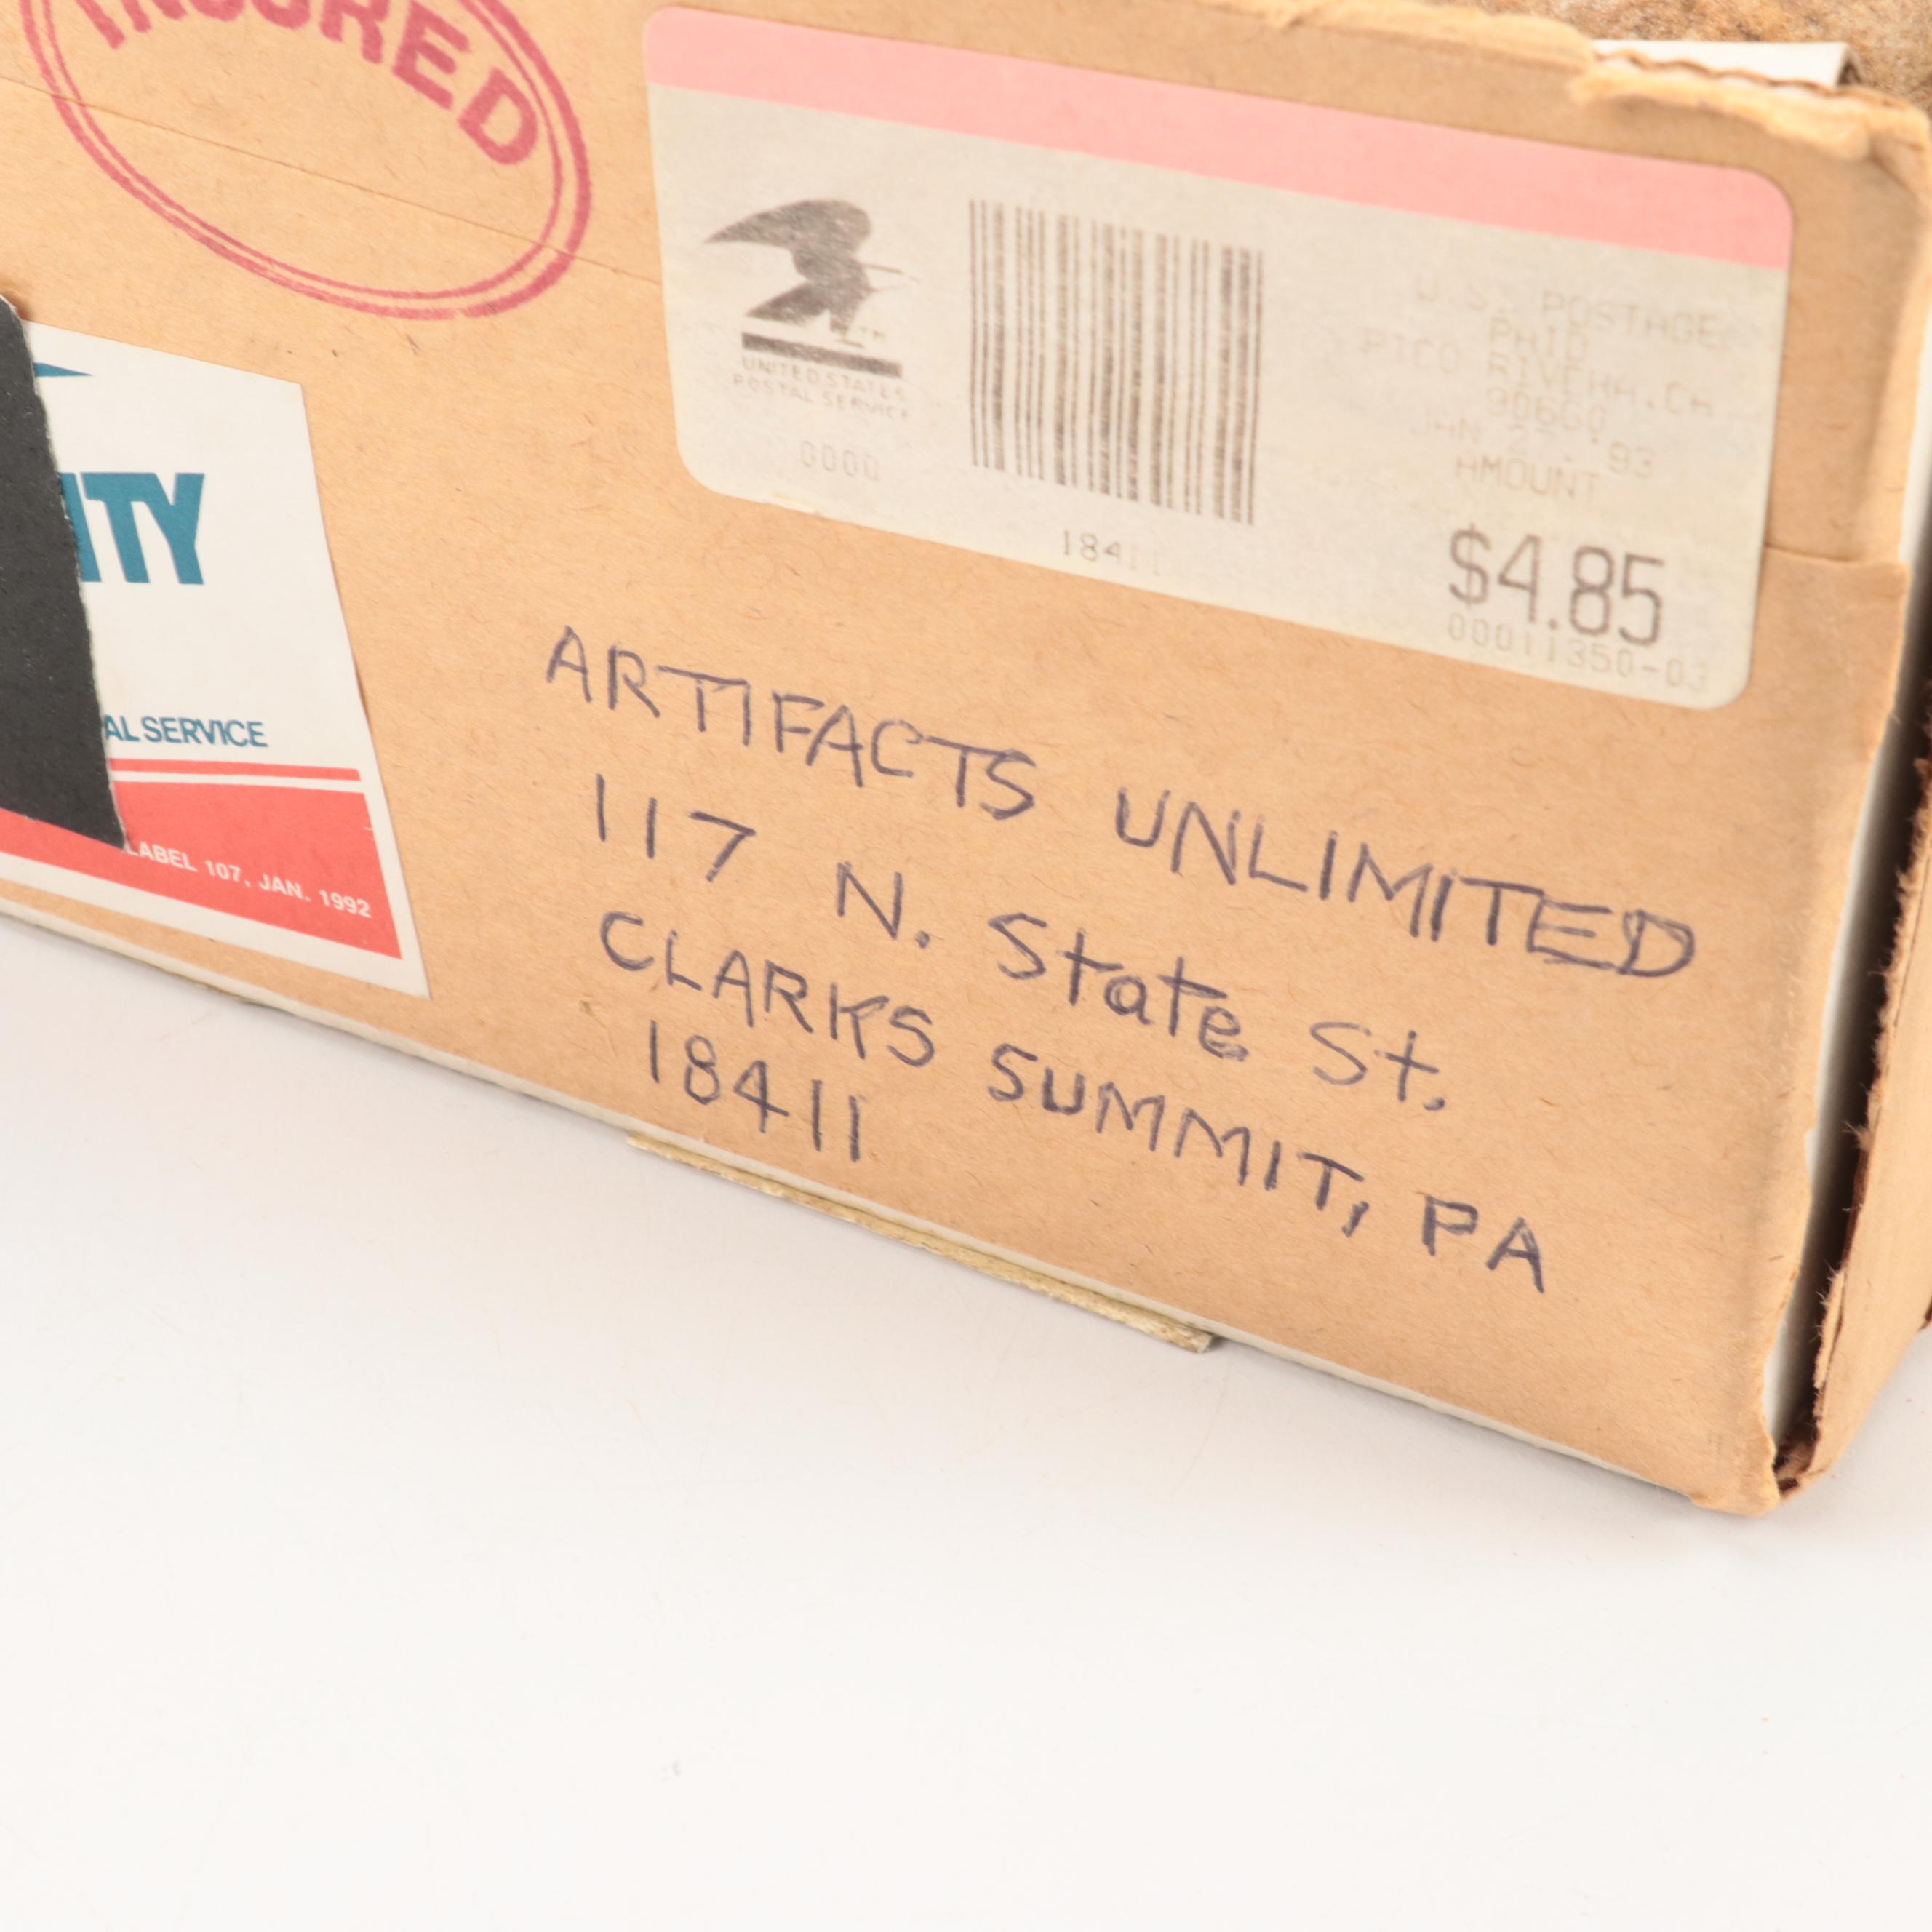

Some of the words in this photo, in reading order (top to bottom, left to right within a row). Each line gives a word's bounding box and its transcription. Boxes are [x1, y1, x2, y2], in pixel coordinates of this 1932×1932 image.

[740, 355, 821, 386] UNITED
[1455, 453, 1602, 502] AMOUNT
[1448, 522, 1666, 648] $4.85
[141, 716, 269, 748] SERVICE
[546, 624, 1037, 821] ARTIFACTS
[1114, 786, 1696, 979] UNLIMITED
[258, 873, 311, 902] JAN.
[318, 889, 372, 919] 1992
[595, 771, 757, 882] 117
[835, 861, 930, 949] N.
[986, 911, 1249, 1062] State
[599, 910, 936, 1068] CLARKS
[986, 1042, 1370, 1239] SUMMIT,
[1421, 1193, 1545, 1294] PA
[649, 1018, 861, 1163] 18411
